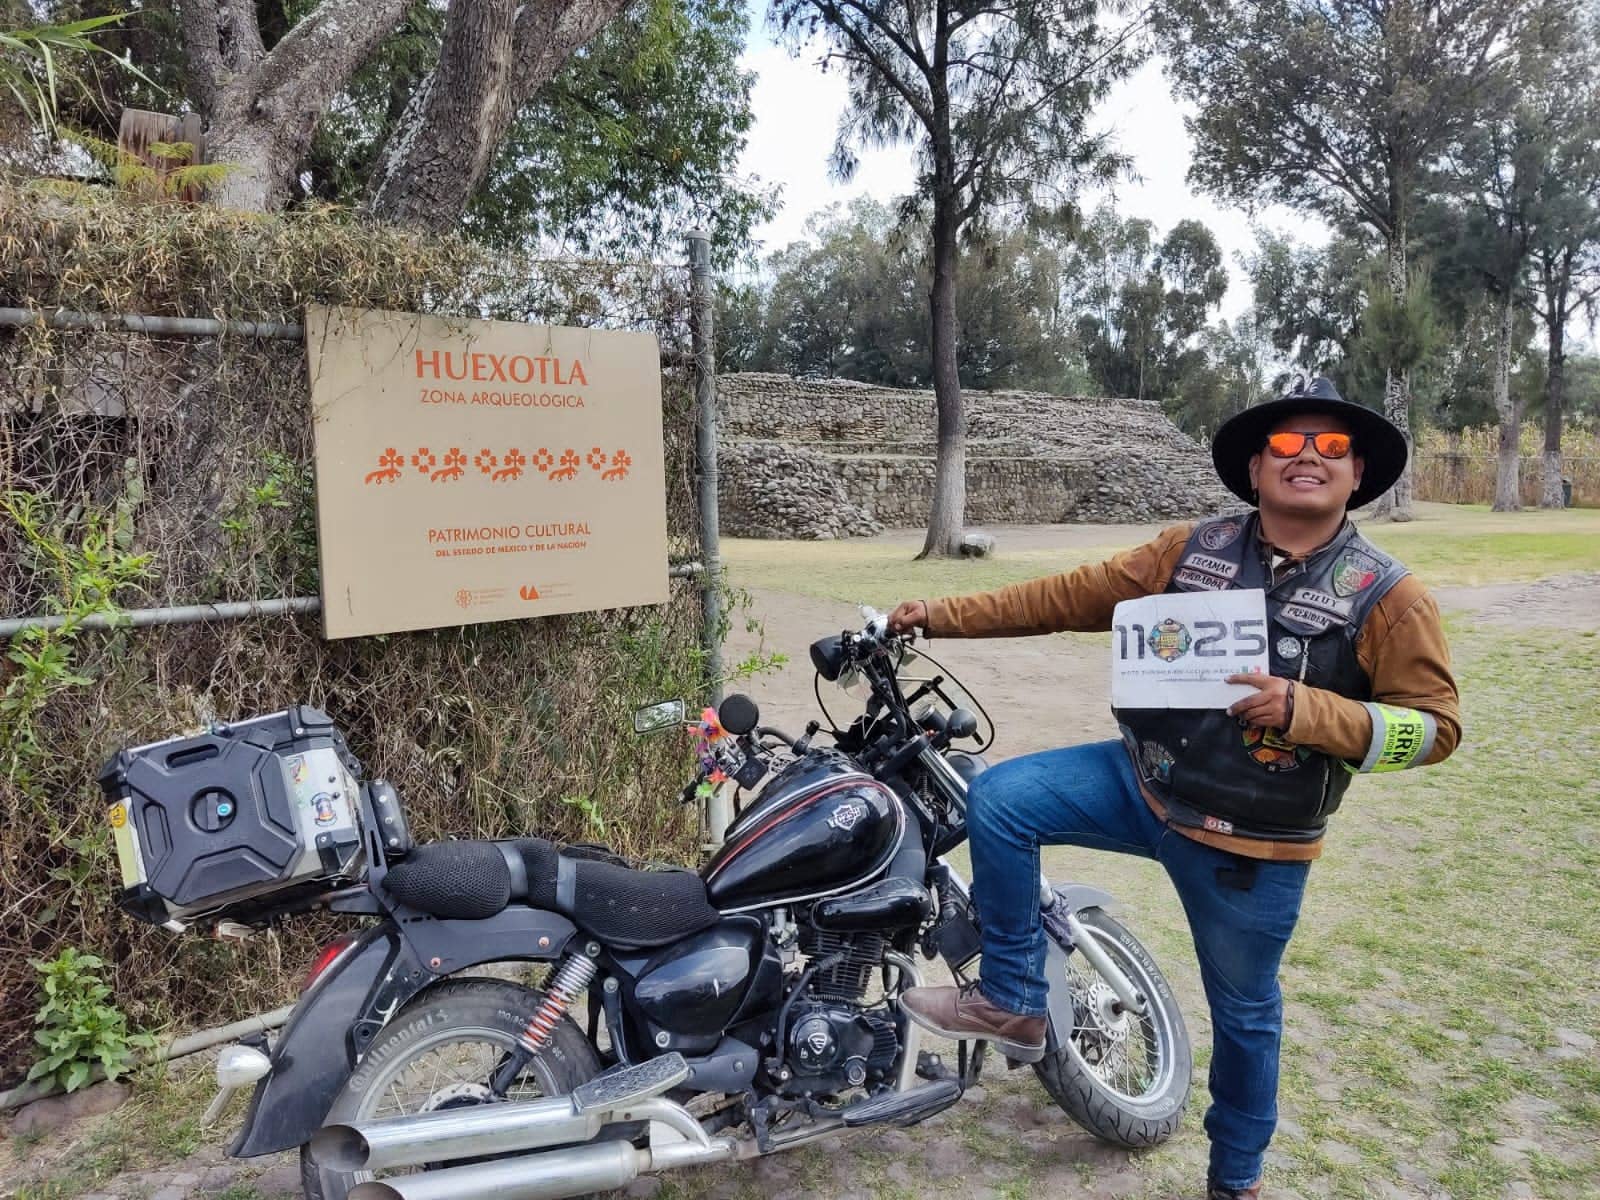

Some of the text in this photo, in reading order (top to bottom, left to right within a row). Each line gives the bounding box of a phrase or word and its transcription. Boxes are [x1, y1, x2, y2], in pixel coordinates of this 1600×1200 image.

[415, 349, 589, 386] HUEXOTLA
[420, 389, 467, 404] ZONA
[428, 521, 591, 544] PATRIMONIO CULTURAL
[435, 549, 450, 558] DEL
[452, 547, 483, 557] ESTADO
[485, 546, 496, 554] DE
[535, 543, 545, 551] DE
[546, 543, 556, 551] LA
[1191, 555, 1233, 575] TECAMAC
[1115, 623, 1145, 660] 11
[1193, 619, 1266, 657] 25
[1386, 723, 1415, 764] RRM
